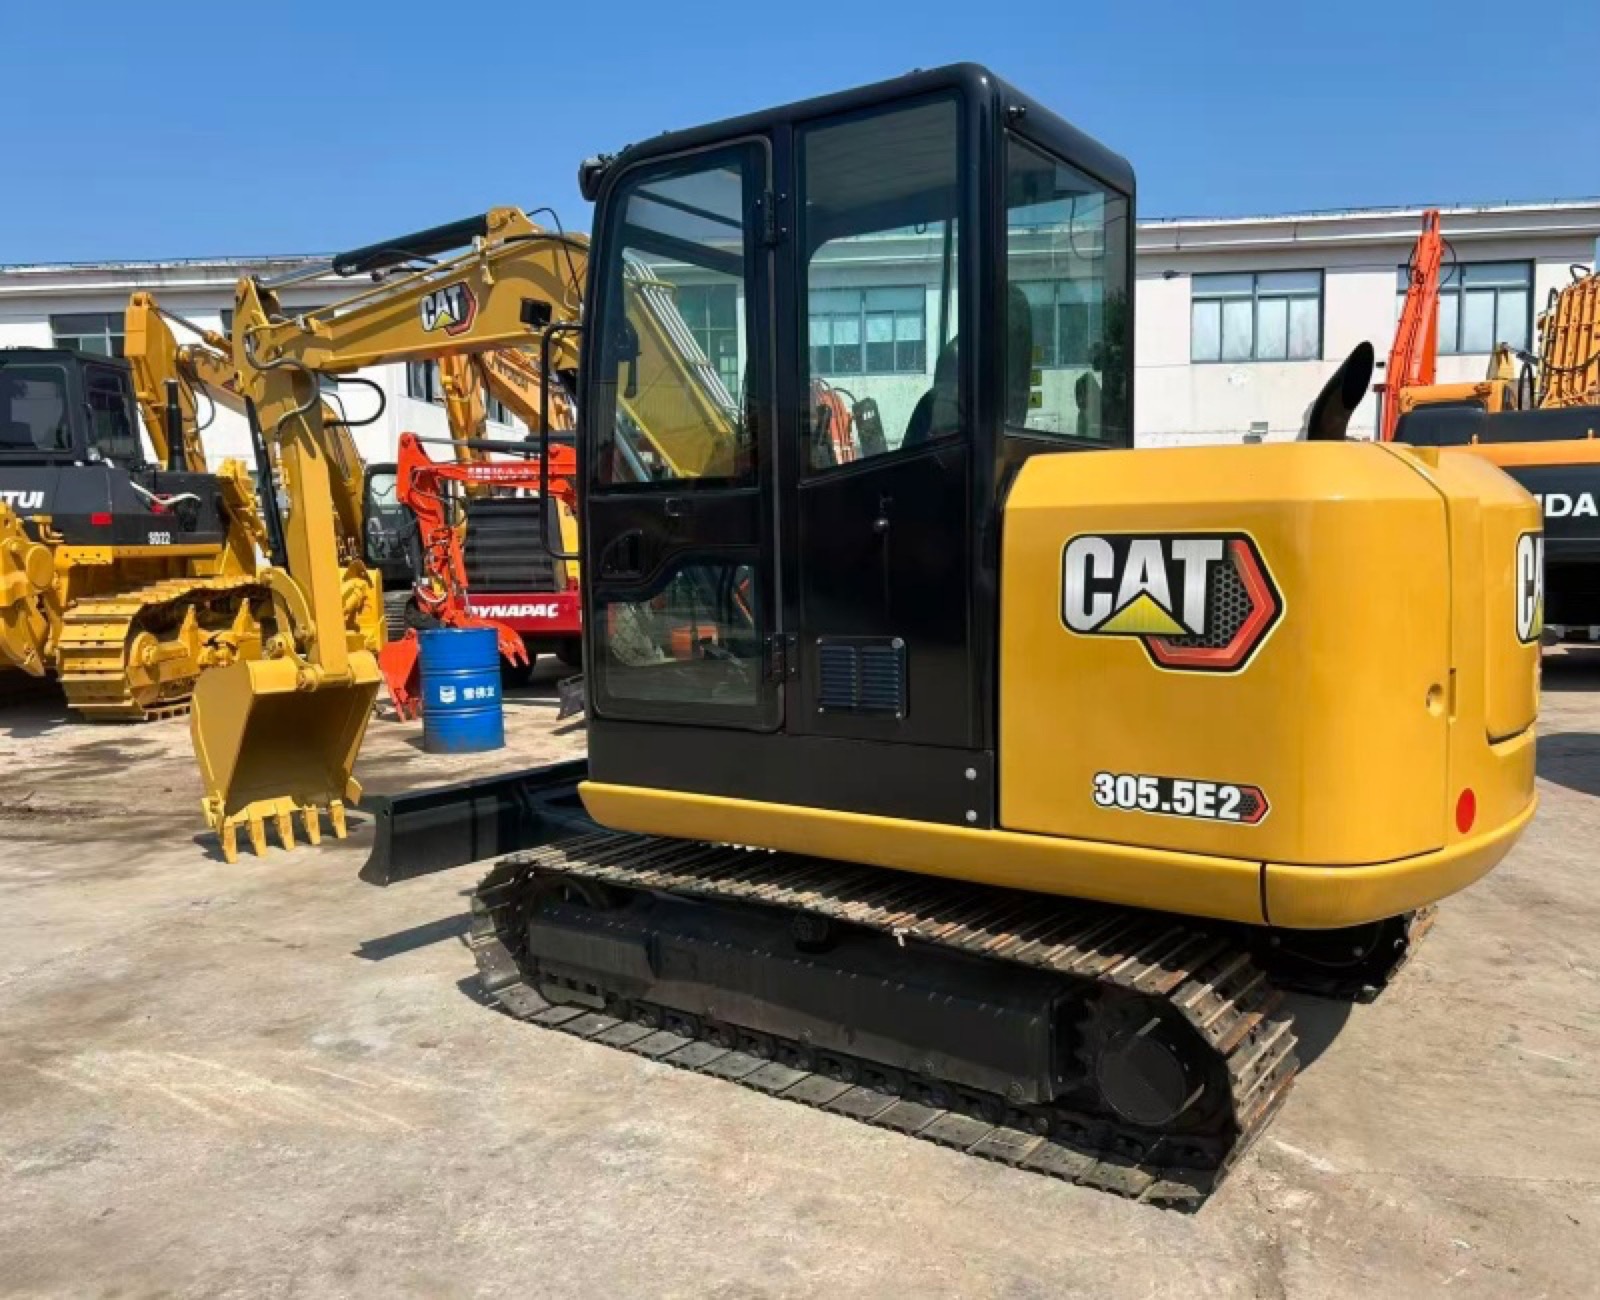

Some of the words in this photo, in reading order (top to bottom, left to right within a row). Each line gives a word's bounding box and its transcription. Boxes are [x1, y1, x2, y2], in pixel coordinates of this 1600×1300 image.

[421, 285, 461, 331] CAT
[0, 490, 45, 509] TUI
[1064, 537, 1223, 635] CAT
[1094, 773, 1242, 821] 305.5E2
